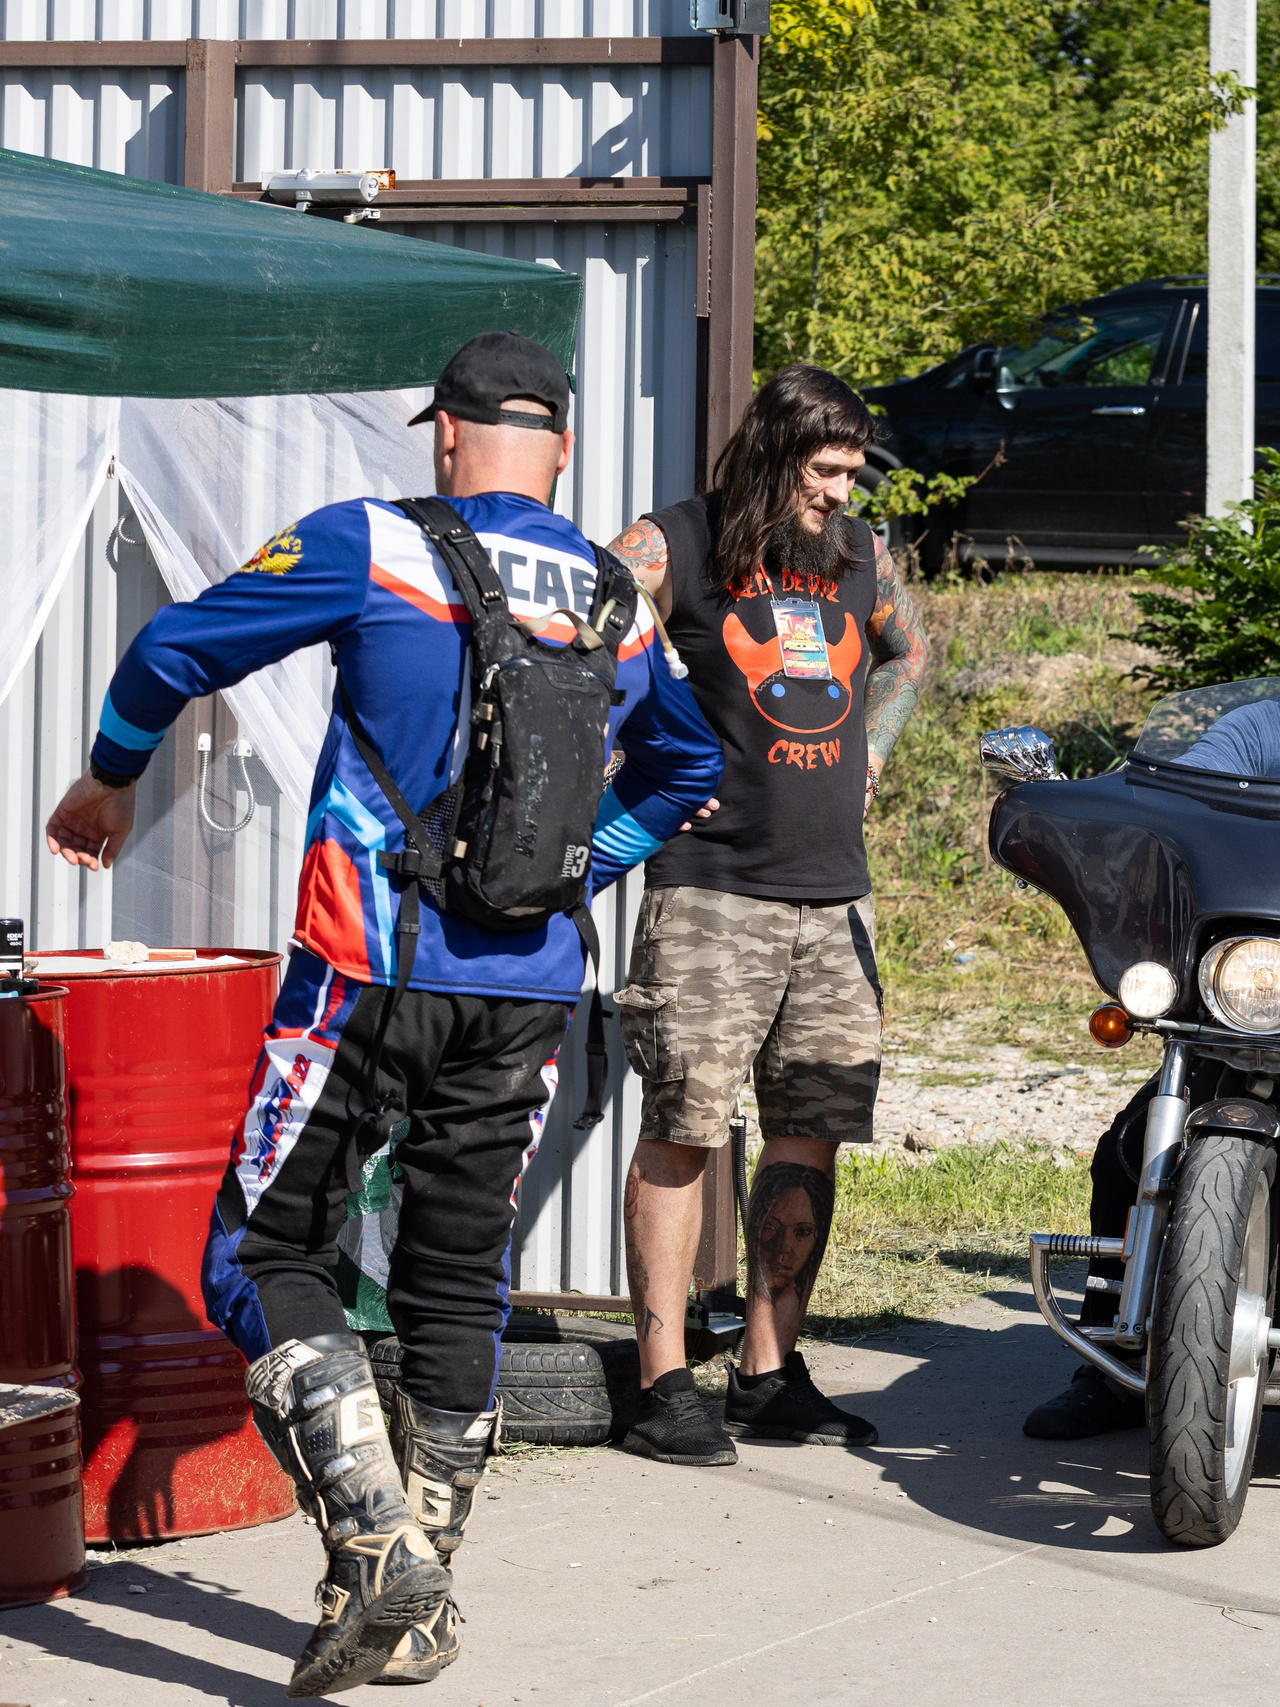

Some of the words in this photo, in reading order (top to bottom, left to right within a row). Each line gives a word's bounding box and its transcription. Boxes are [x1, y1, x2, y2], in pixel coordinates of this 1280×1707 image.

[768, 738, 841, 770] CREW
[561, 844, 577, 878] HYDRO
[571, 845, 590, 878] 3
